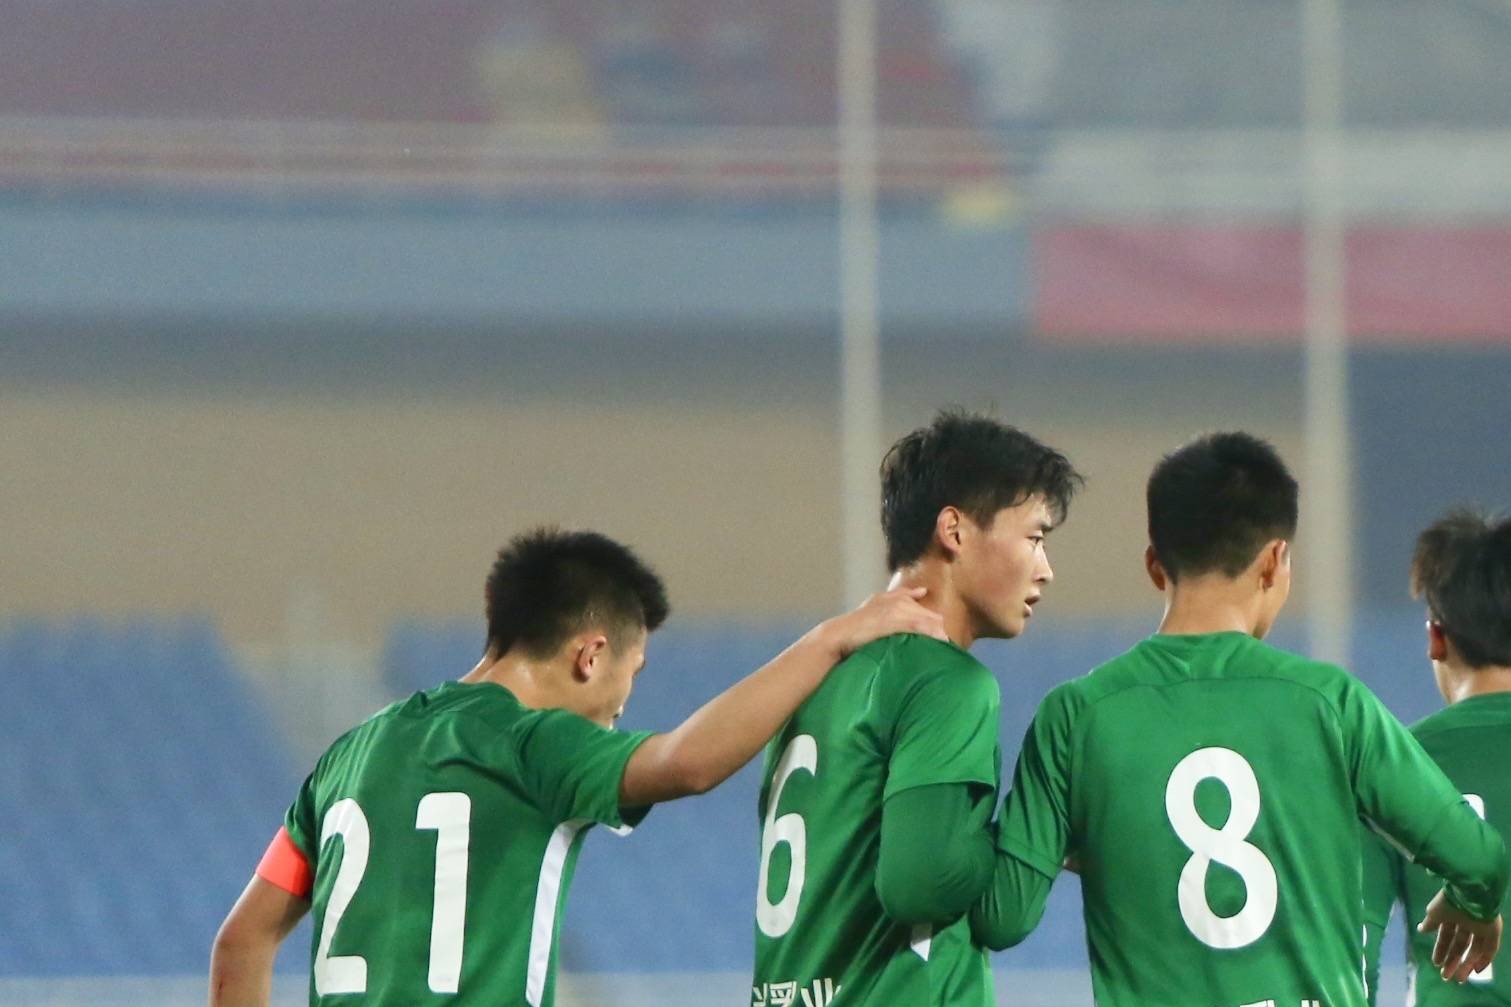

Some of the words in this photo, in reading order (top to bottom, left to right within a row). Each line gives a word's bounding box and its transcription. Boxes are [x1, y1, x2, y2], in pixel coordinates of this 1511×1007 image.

[314, 791, 472, 995] 21
[756, 734, 818, 938] 6
[1165, 746, 1278, 949] 8
